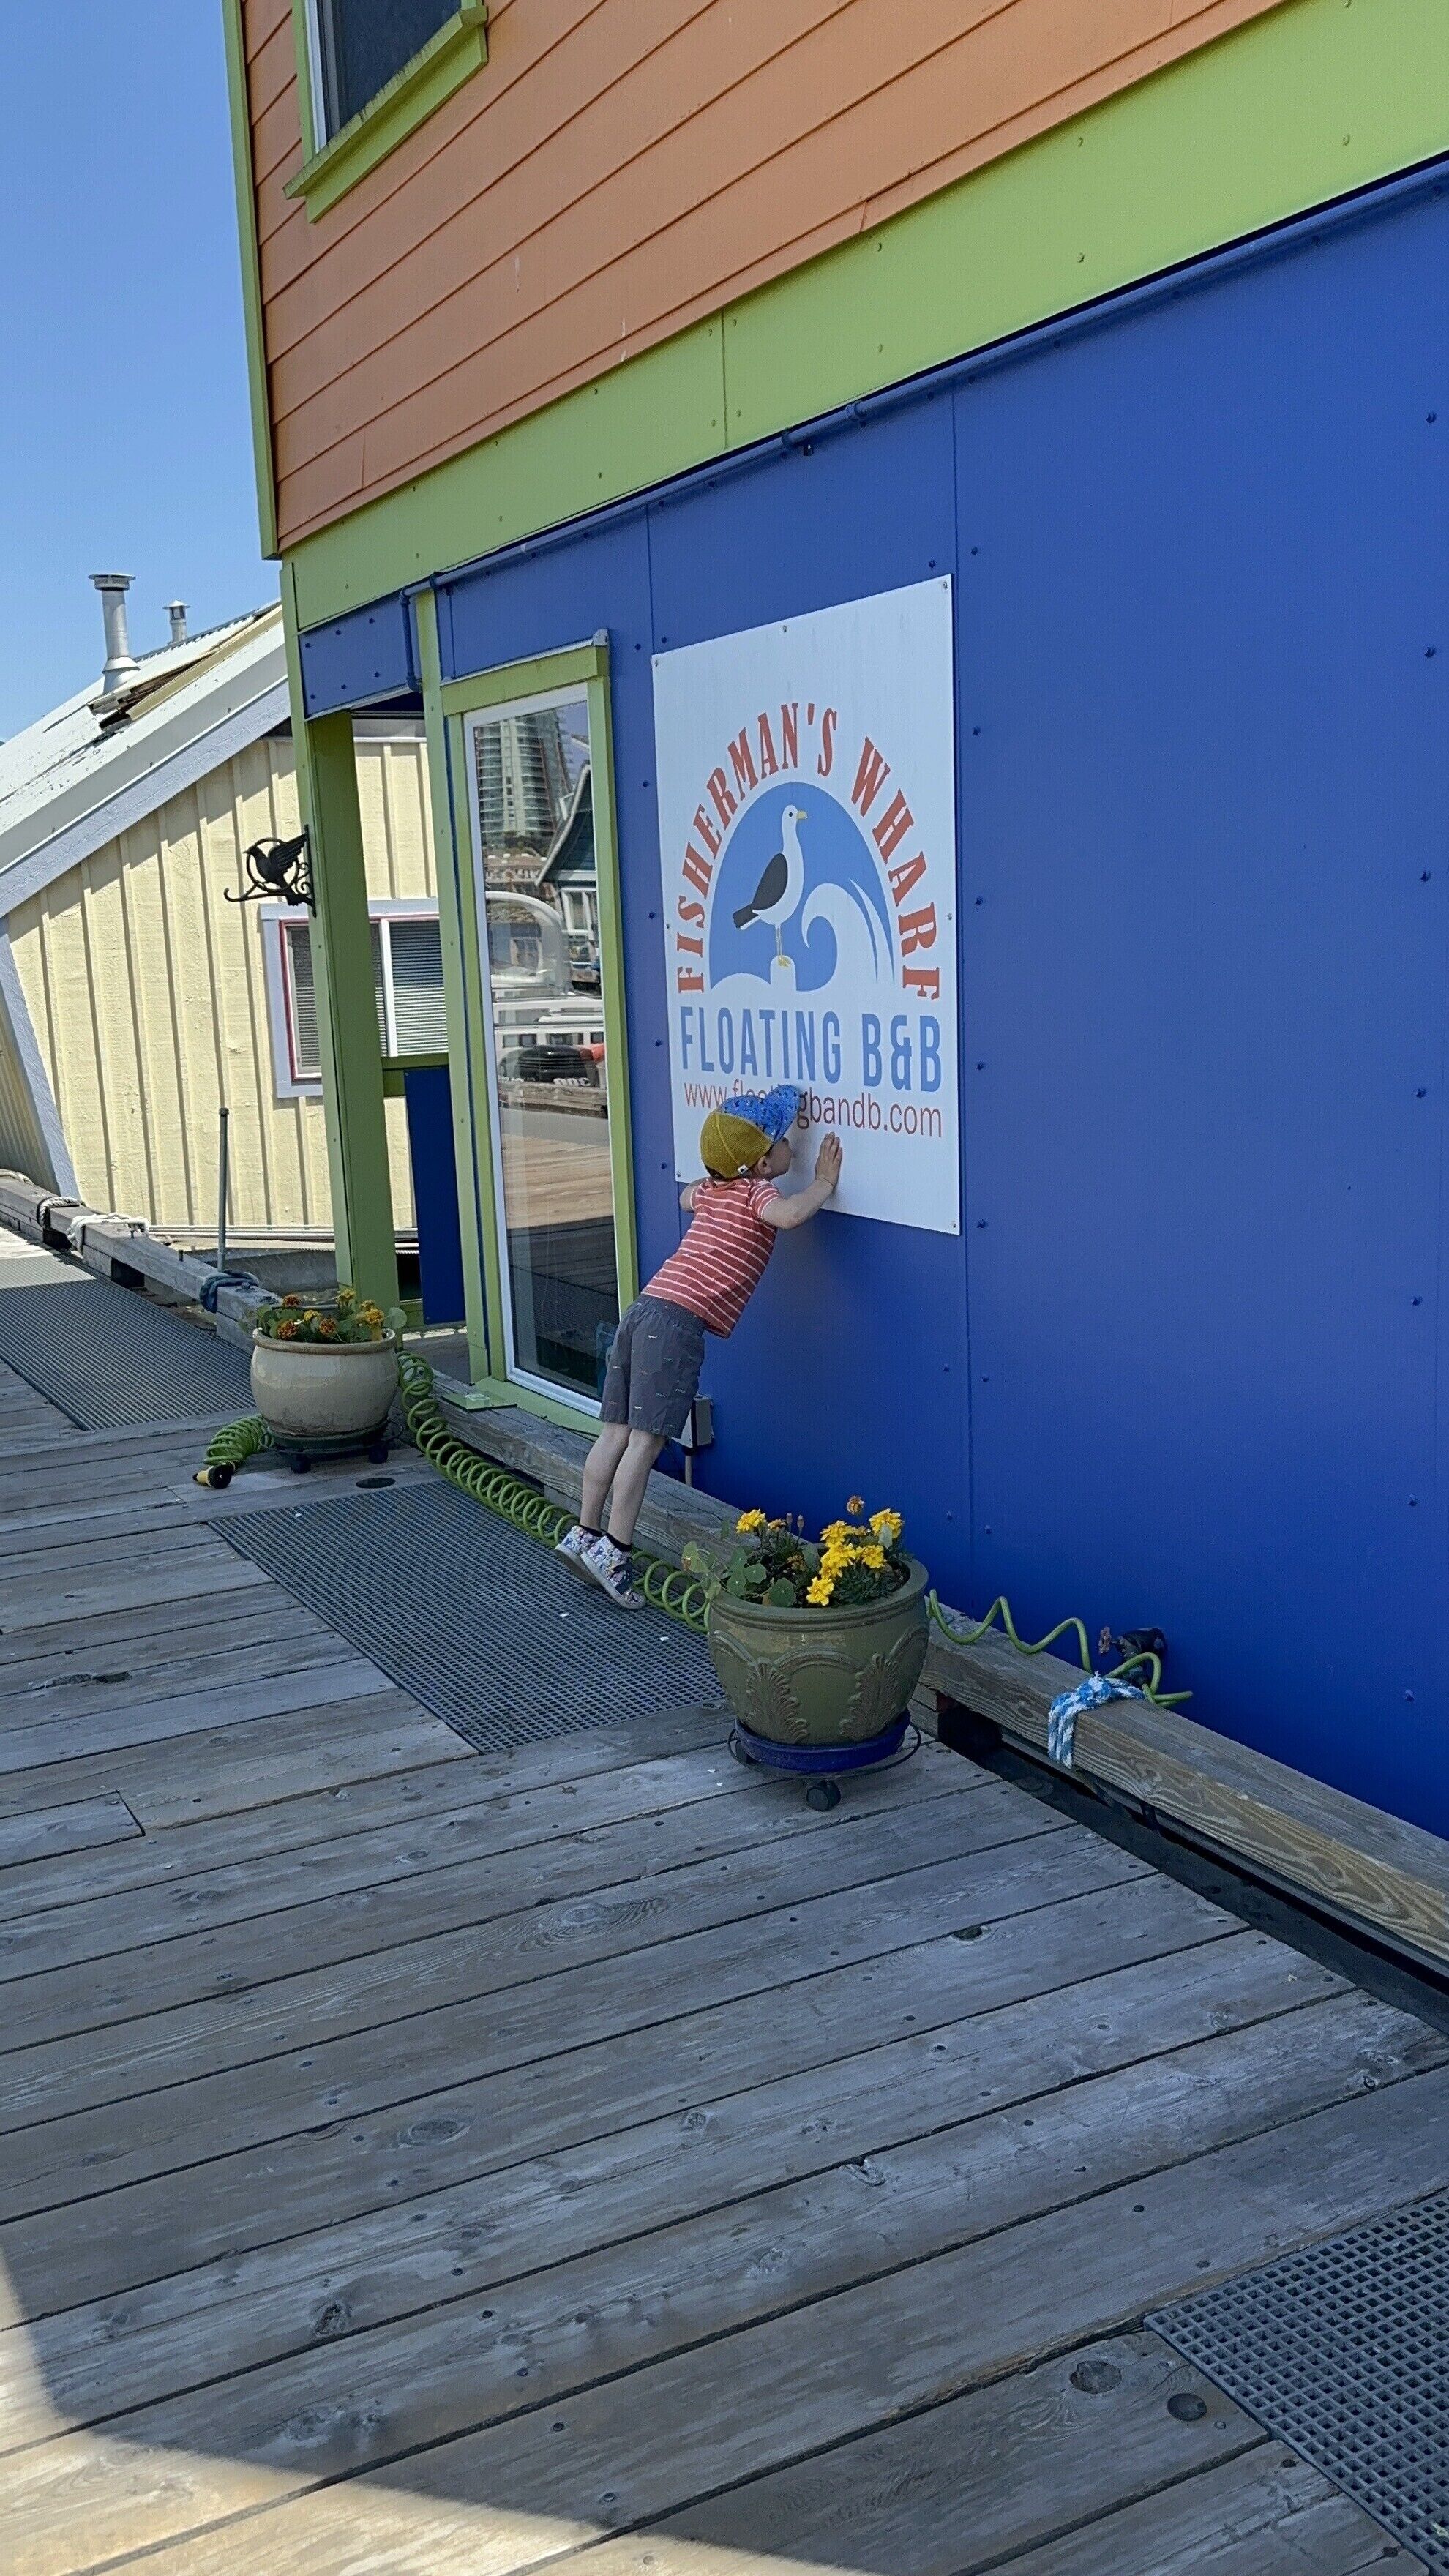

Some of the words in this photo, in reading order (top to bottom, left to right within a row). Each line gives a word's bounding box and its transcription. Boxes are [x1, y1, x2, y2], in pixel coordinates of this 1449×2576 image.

[677, 702, 838, 994] FISHERMAN'S
[850, 736, 940, 1000] WHARF
[680, 1006, 841, 1085] FLOATING
[862, 1013, 942, 1093] B&B
